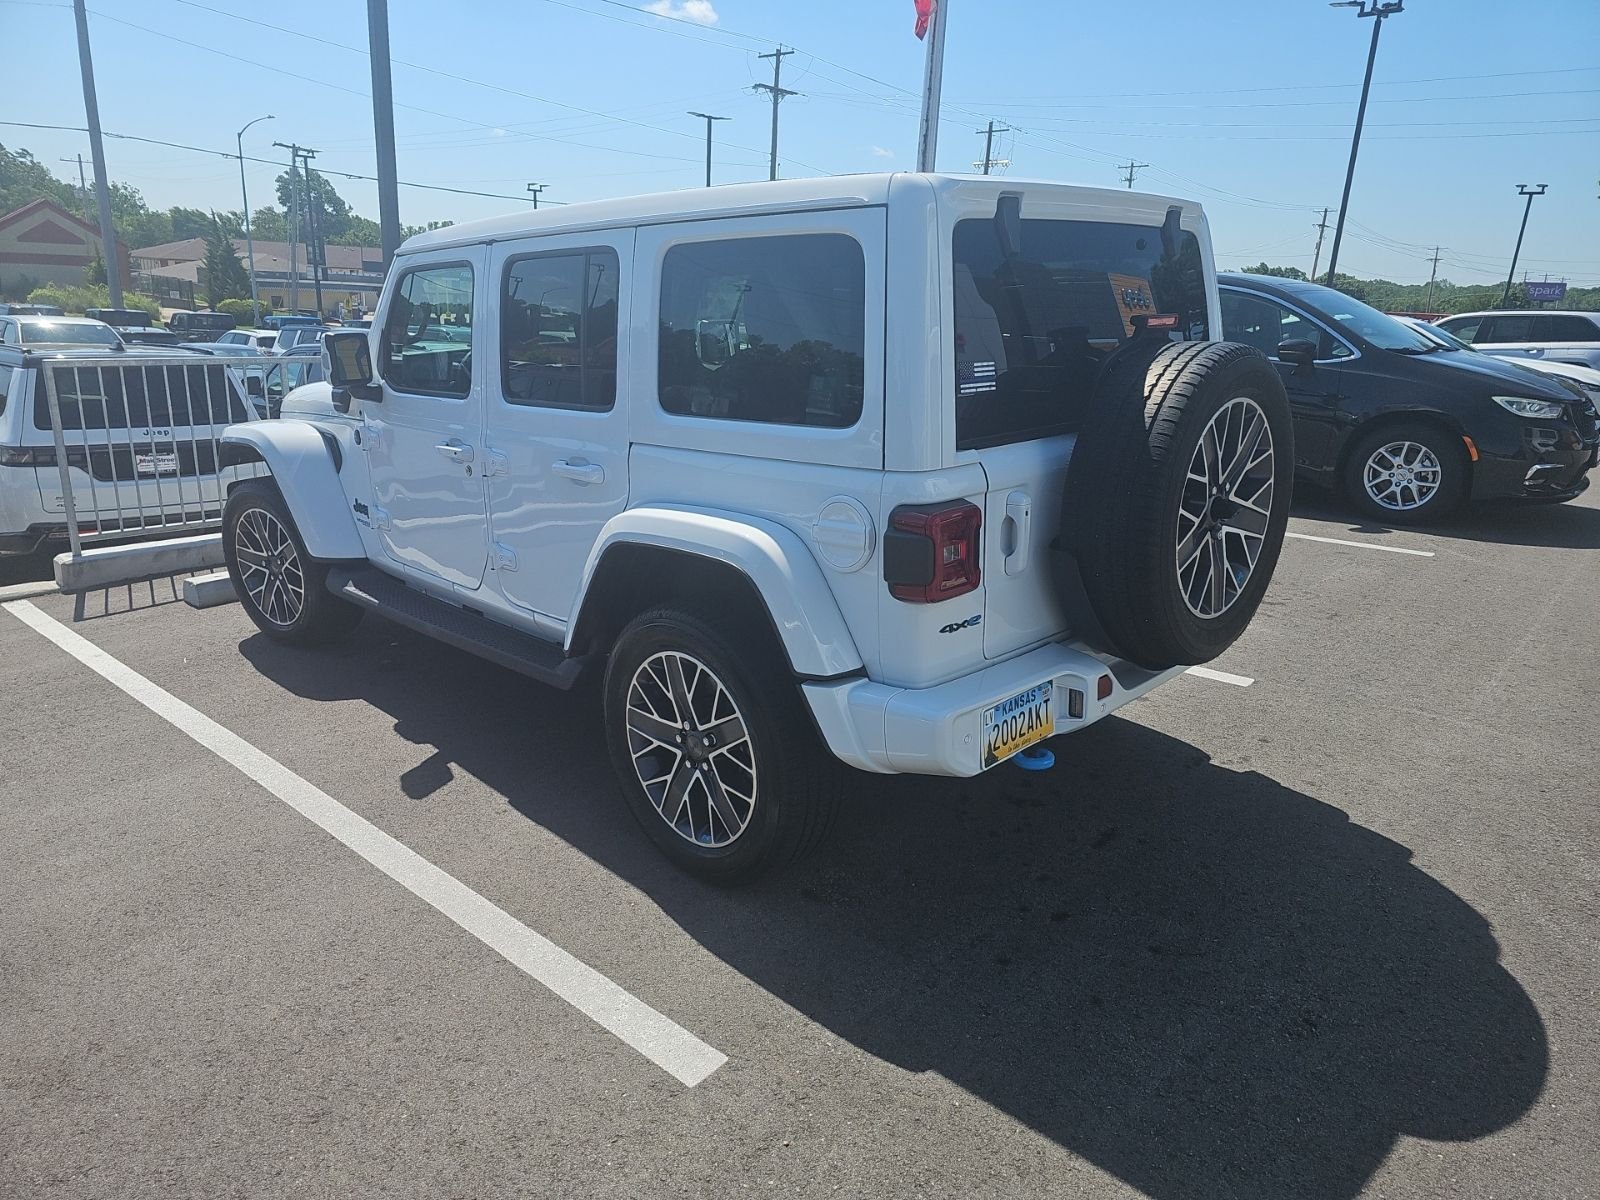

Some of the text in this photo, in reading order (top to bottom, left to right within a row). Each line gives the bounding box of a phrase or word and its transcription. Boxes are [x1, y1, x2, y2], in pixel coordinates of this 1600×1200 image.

[1529, 285, 1562, 297] spark
[1002, 689, 1036, 716] KANSAS
[992, 698, 1050, 752] 2002AKT
